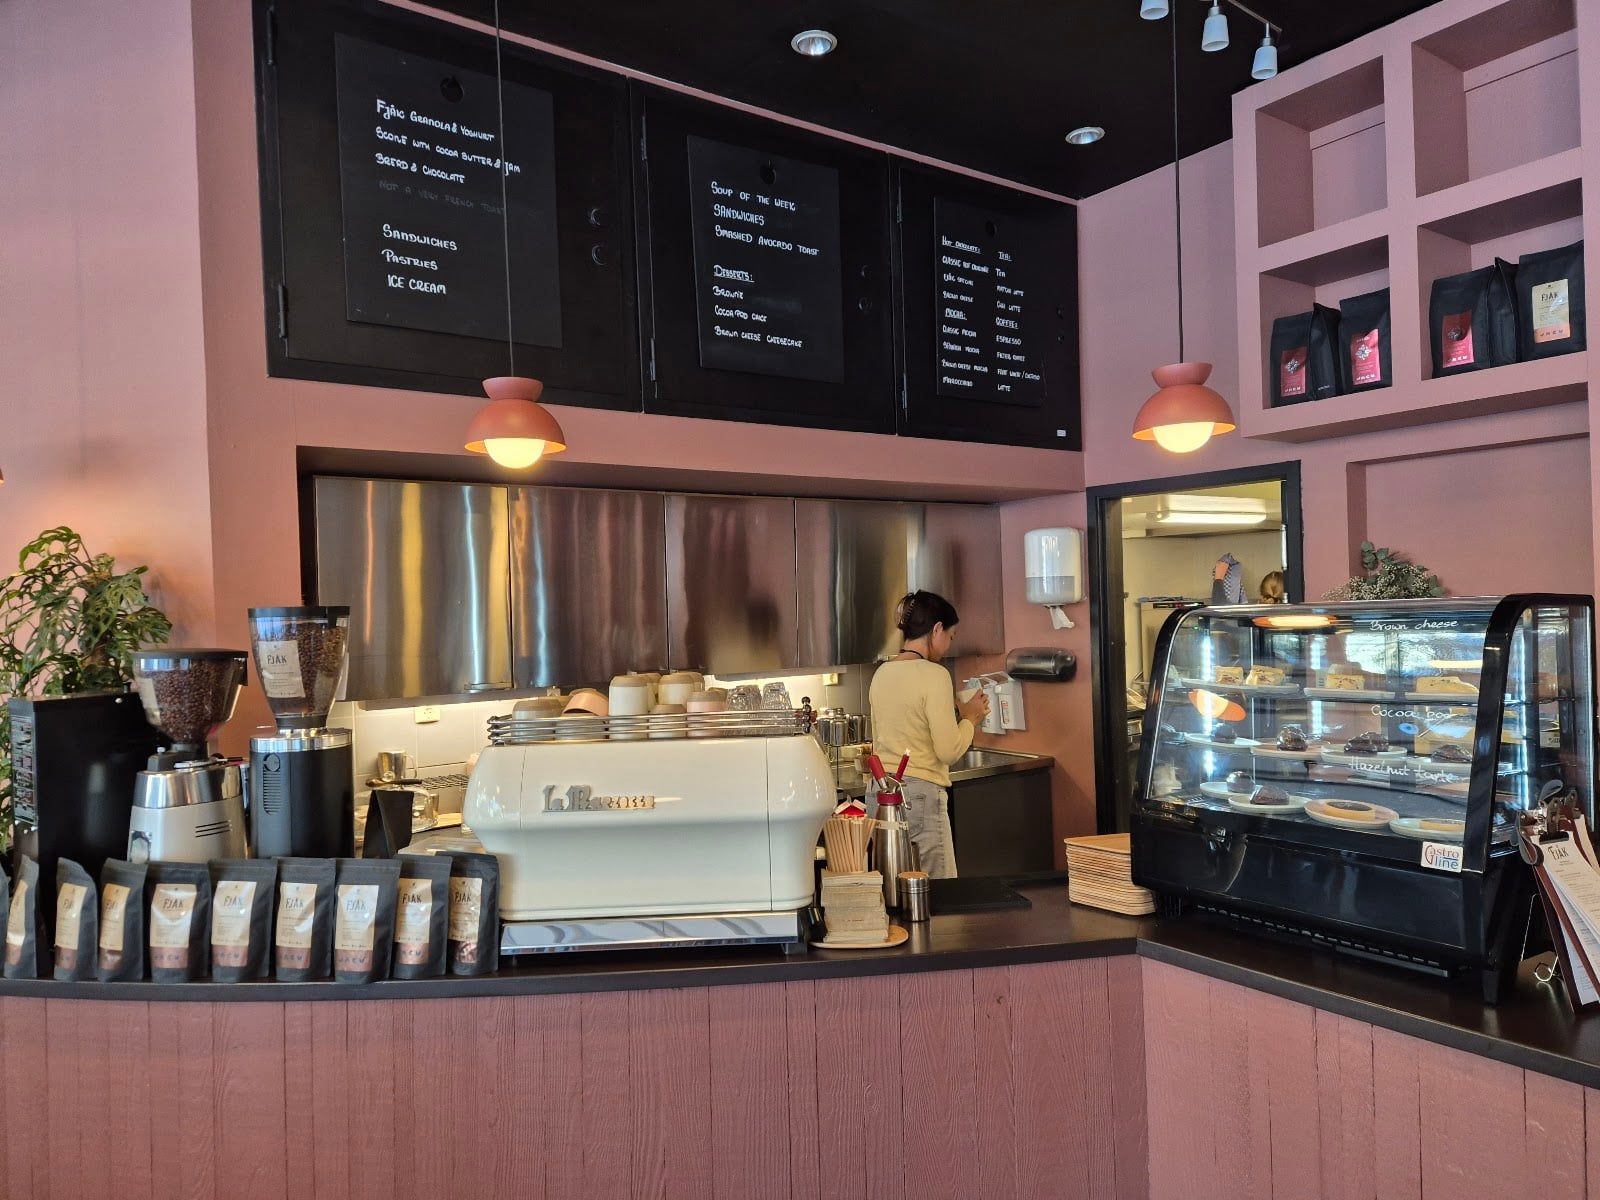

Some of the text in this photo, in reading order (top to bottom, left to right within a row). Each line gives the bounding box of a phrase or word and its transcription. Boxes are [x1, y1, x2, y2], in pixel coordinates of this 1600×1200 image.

[375, 126, 408, 145] SCONE
[412, 139, 431, 151] WITH
[436, 145, 459, 158] COCOA
[461, 152, 493, 167] BUTTER
[375, 152, 408, 170] BREAD
[422, 165, 466, 184] CHOCOLATE
[711, 180, 796, 212] SOUP OF THE WEEK
[713, 203, 765, 226] SANDWICHES
[383, 223, 458, 251] SANDWICHES
[715, 224, 820, 256] SMASHED AVOCADO TOAST
[381, 248, 439, 271] PASTRIES
[387, 273, 447, 295] ICE CREAM
[712, 285, 744, 300] BROWNIE
[1369, 618, 1460, 632] Brown cheese
